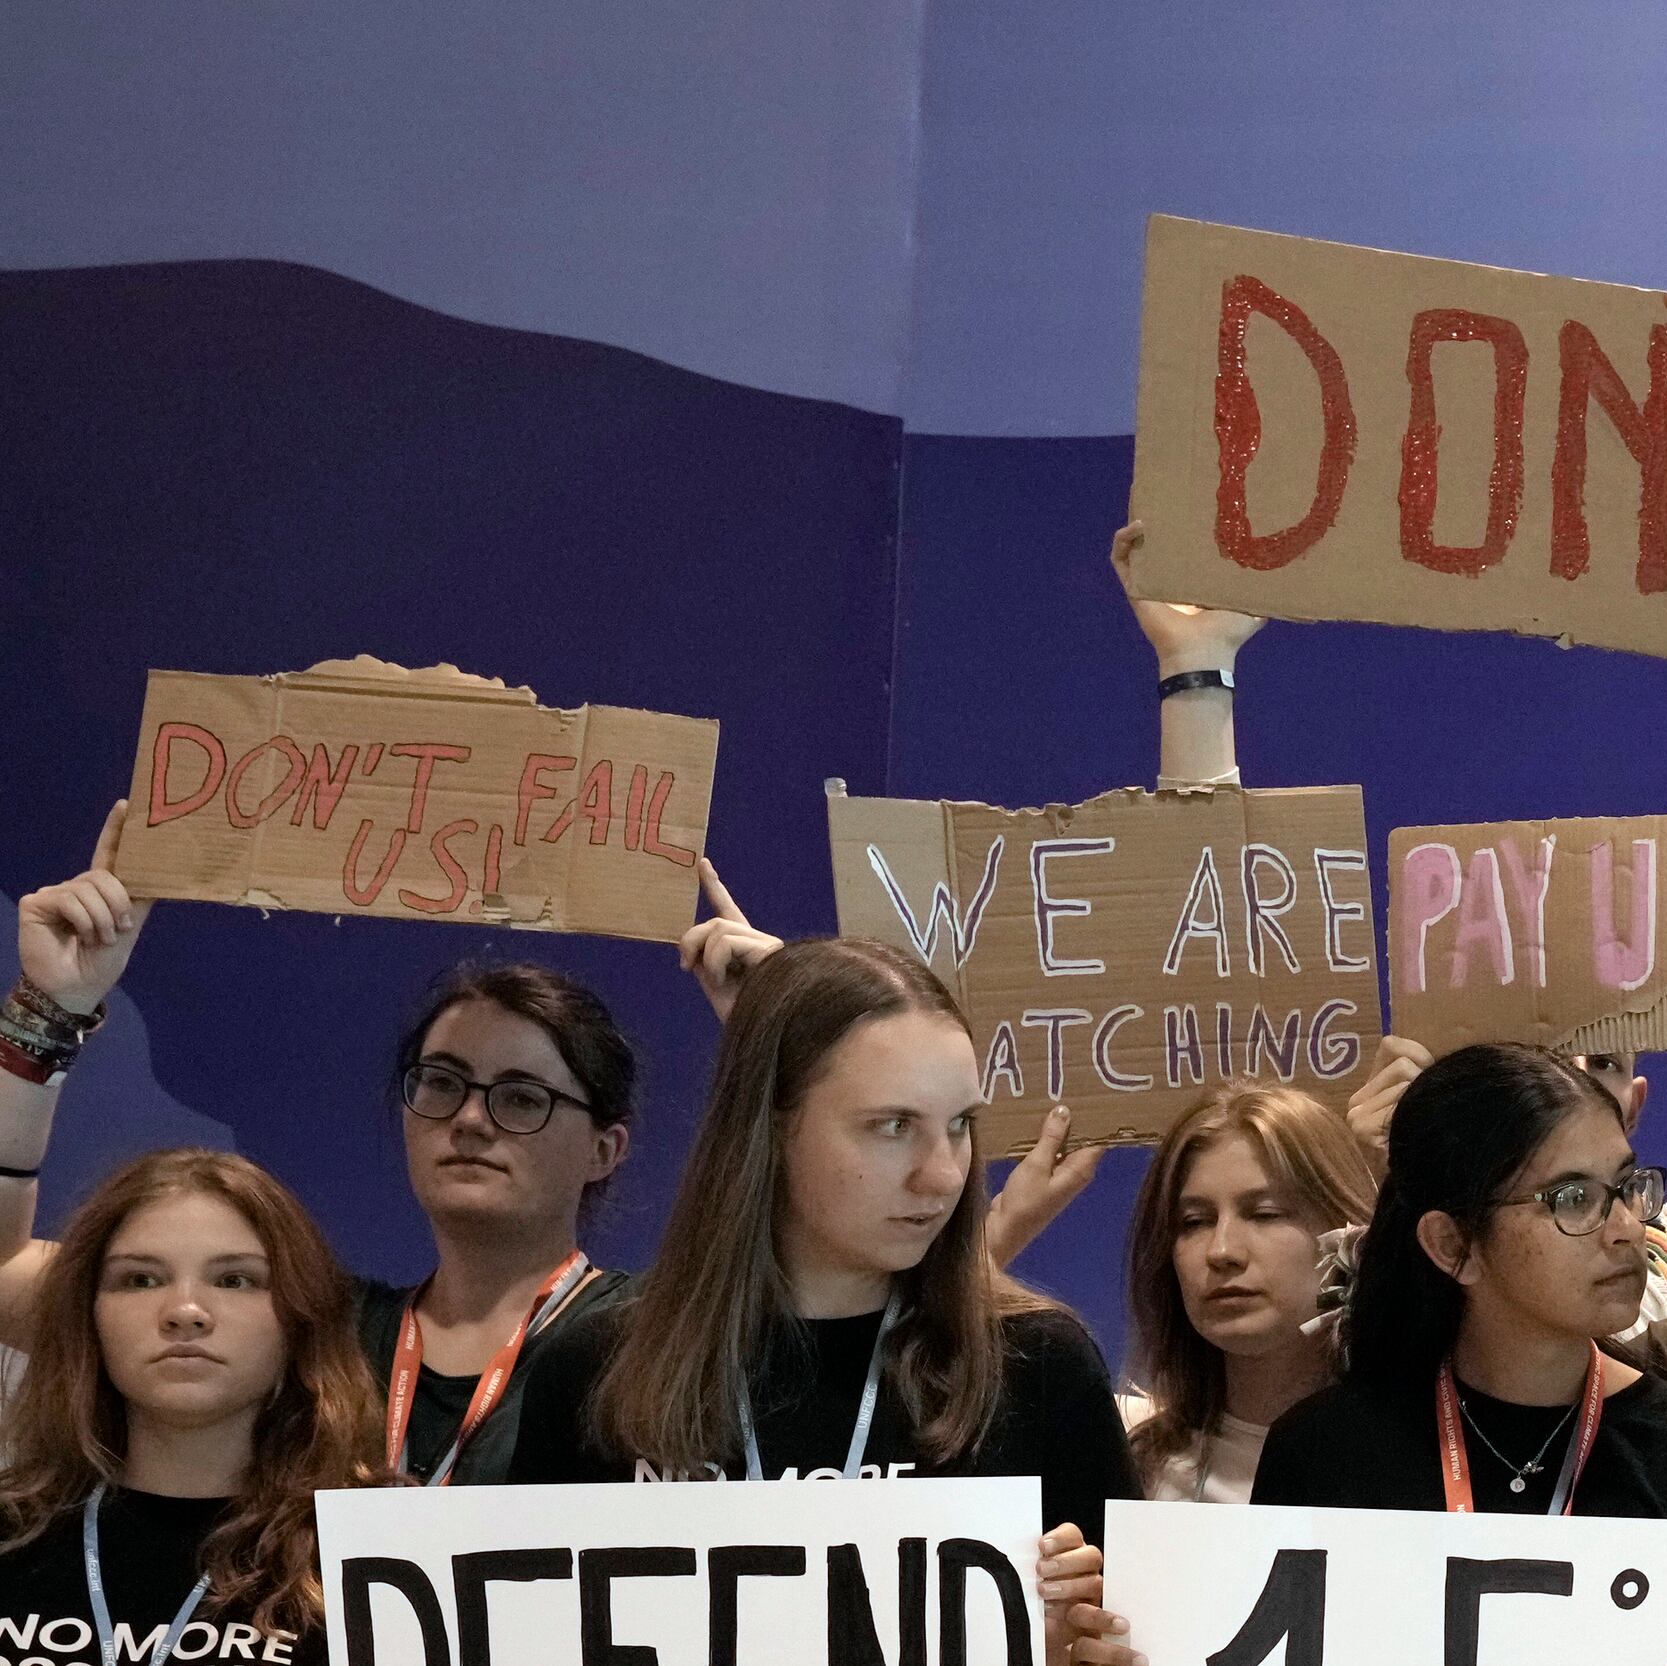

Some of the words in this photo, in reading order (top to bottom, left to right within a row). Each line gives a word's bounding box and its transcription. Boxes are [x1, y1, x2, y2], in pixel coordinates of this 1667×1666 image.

[147, 721, 471, 834] DON'T
[514, 752, 697, 867] FAIL
[342, 817, 505, 914] US!
[866, 836, 1116, 976] WE
[1163, 843, 1371, 978] ARE
[1404, 833, 1557, 993] PAY
[982, 1000, 1361, 1104] ATCHING
[857, 1383, 878, 1429] UNFCCC
[1445, 1419, 1457, 1450] RIGHTS
[1450, 1449, 1462, 1481] HUMAN
